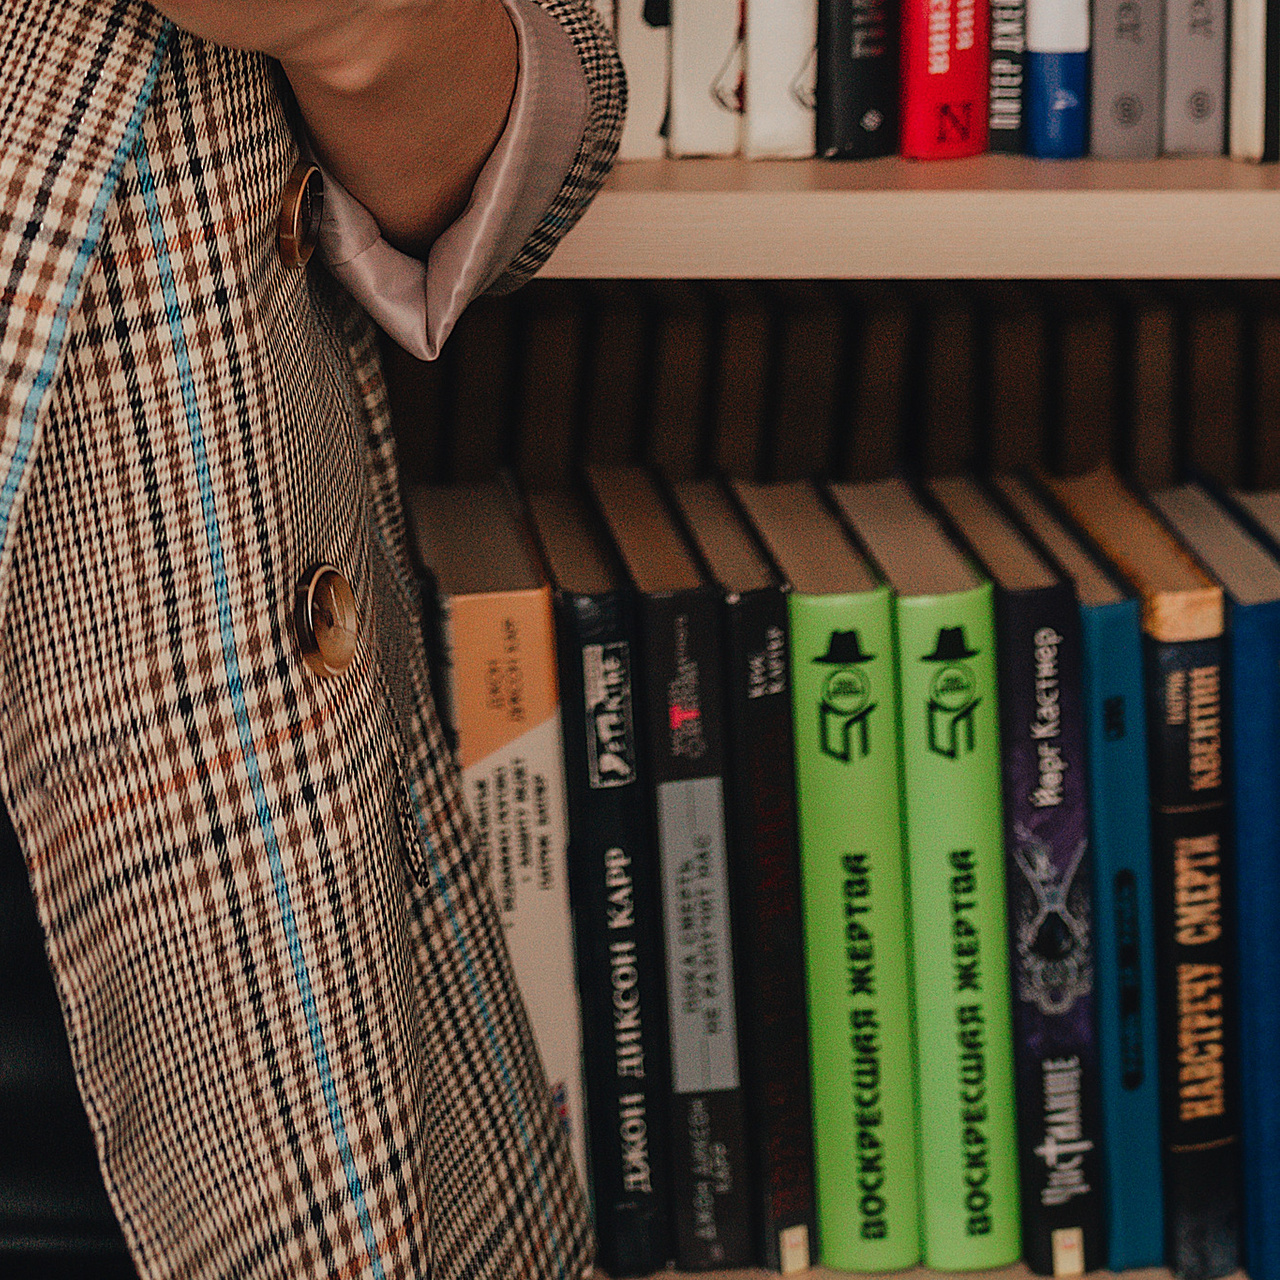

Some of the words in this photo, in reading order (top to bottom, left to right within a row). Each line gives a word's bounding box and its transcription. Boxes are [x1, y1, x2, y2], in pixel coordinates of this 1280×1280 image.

[988, 58, 1023, 130] ПИТЕР
[1031, 627, 1064, 738] Кастнер
[1189, 666, 1221, 790] КВЕНТИН
[1030, 743, 1069, 807] Йорг
[603, 847, 634, 930] КАРР
[676, 858, 698, 942] СМЕРТЬ
[693, 835, 713, 878] НАС
[1174, 834, 1221, 945] СМЕРТИ
[697, 884, 719, 999] РАЗЛУЧИТ
[841, 853, 877, 997] ЖЕРТВА
[947, 849, 983, 992] ЖЕРТВА
[609, 942, 646, 1079] ДИКСОН
[679, 947, 701, 1014] ПОКА
[702, 1006, 720, 1035] НЕ
[1177, 963, 1224, 1122] НАВСТРЕЧУ
[618, 1093, 652, 1193] ДЖОН
[848, 1008, 888, 1240] ВОСКРЕСШАЯ
[954, 1005, 994, 1236] ВОСКРЕСШАЯ
